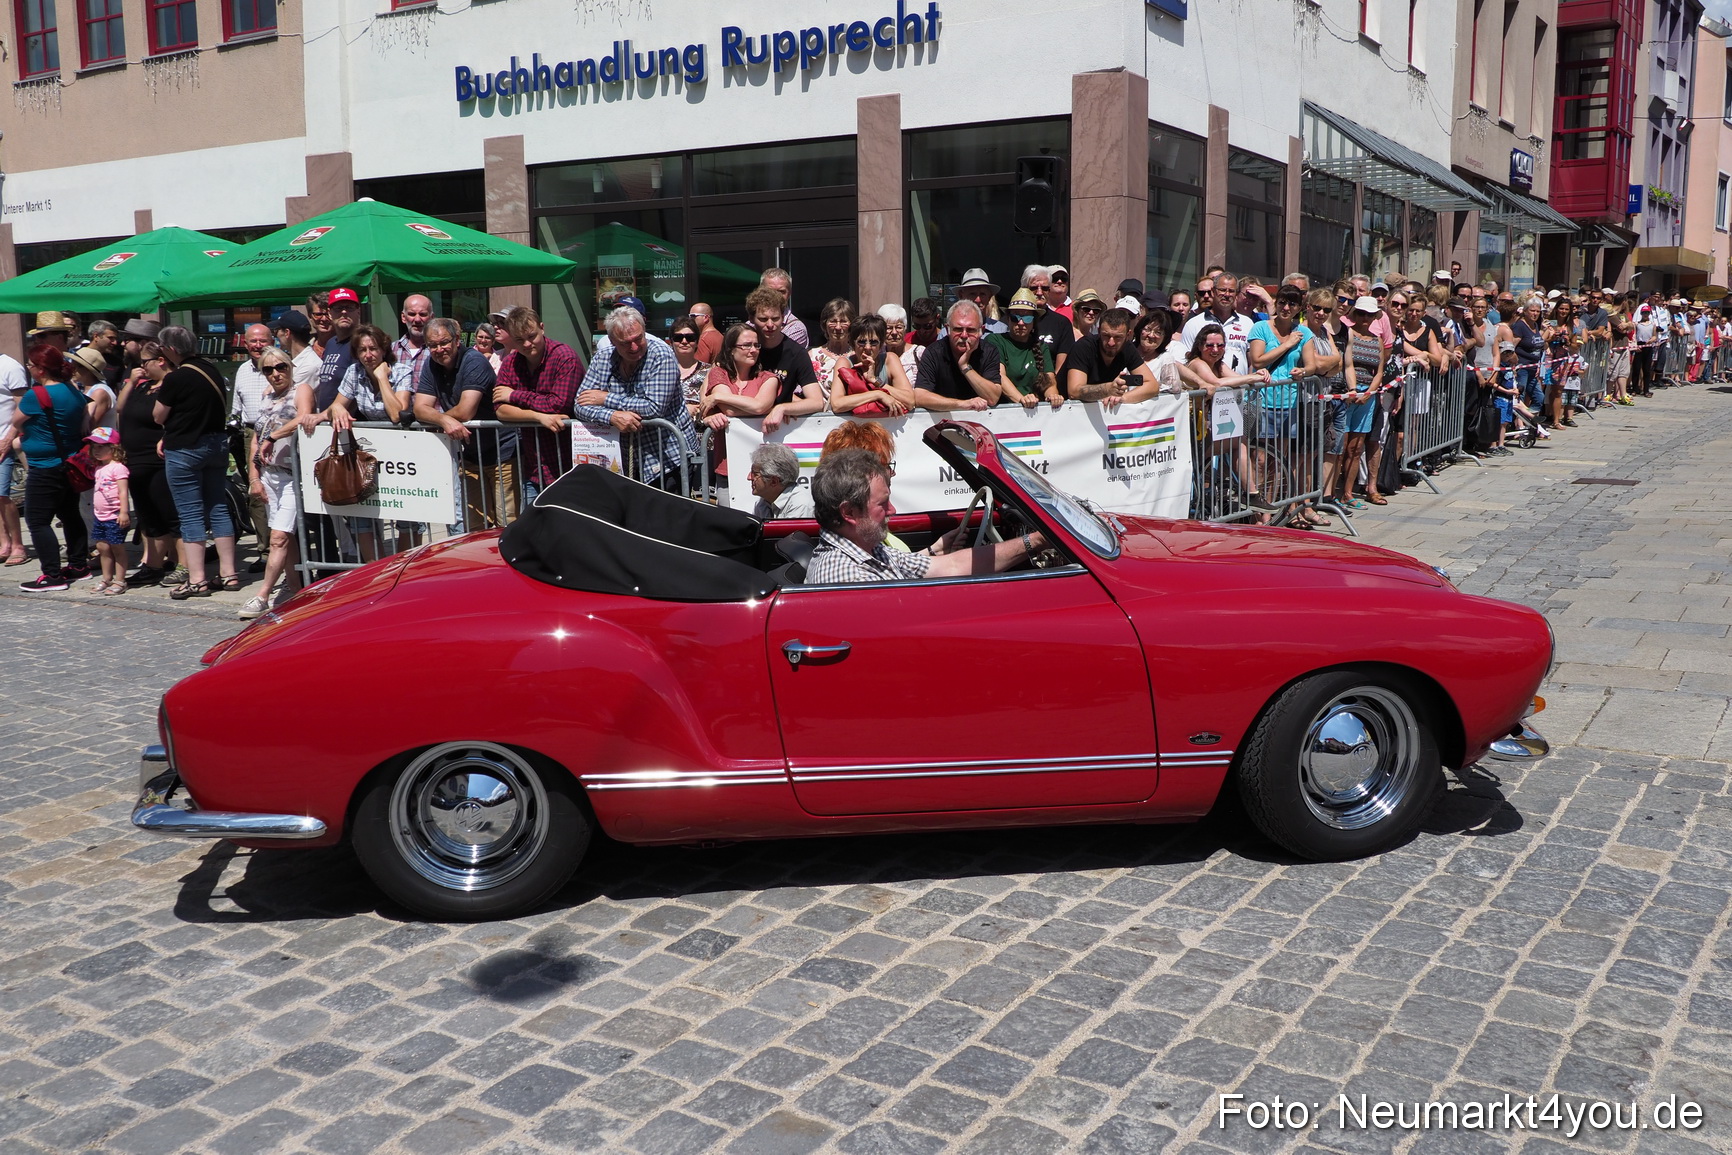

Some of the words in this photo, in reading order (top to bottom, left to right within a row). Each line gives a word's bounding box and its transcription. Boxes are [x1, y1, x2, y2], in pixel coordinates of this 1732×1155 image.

[454, 39, 705, 102] Buchhandlung
[720, 0, 940, 74] Rupprecht
[1629, 193, 1638, 202] IL
[3, 203, 25, 215] Unterer
[25, 200, 44, 212] Markt
[44, 199, 52, 211] 15
[254, 246, 323, 257] Neumarkter
[227, 252, 323, 268] Lammsbräu
[61, 272, 121, 280] Neumarkter
[600, 267, 631, 278] OLDTIMER
[35, 278, 120, 288] Lammsbräu
[1102, 445, 1177, 470] NeuerMarkt
[377, 459, 417, 476] ress
[1106, 473, 1141, 482] einkaufen
[376, 485, 439, 498] emeinschaft
[944, 486, 975, 496] einkauf
[358, 498, 404, 509] eumarkt
